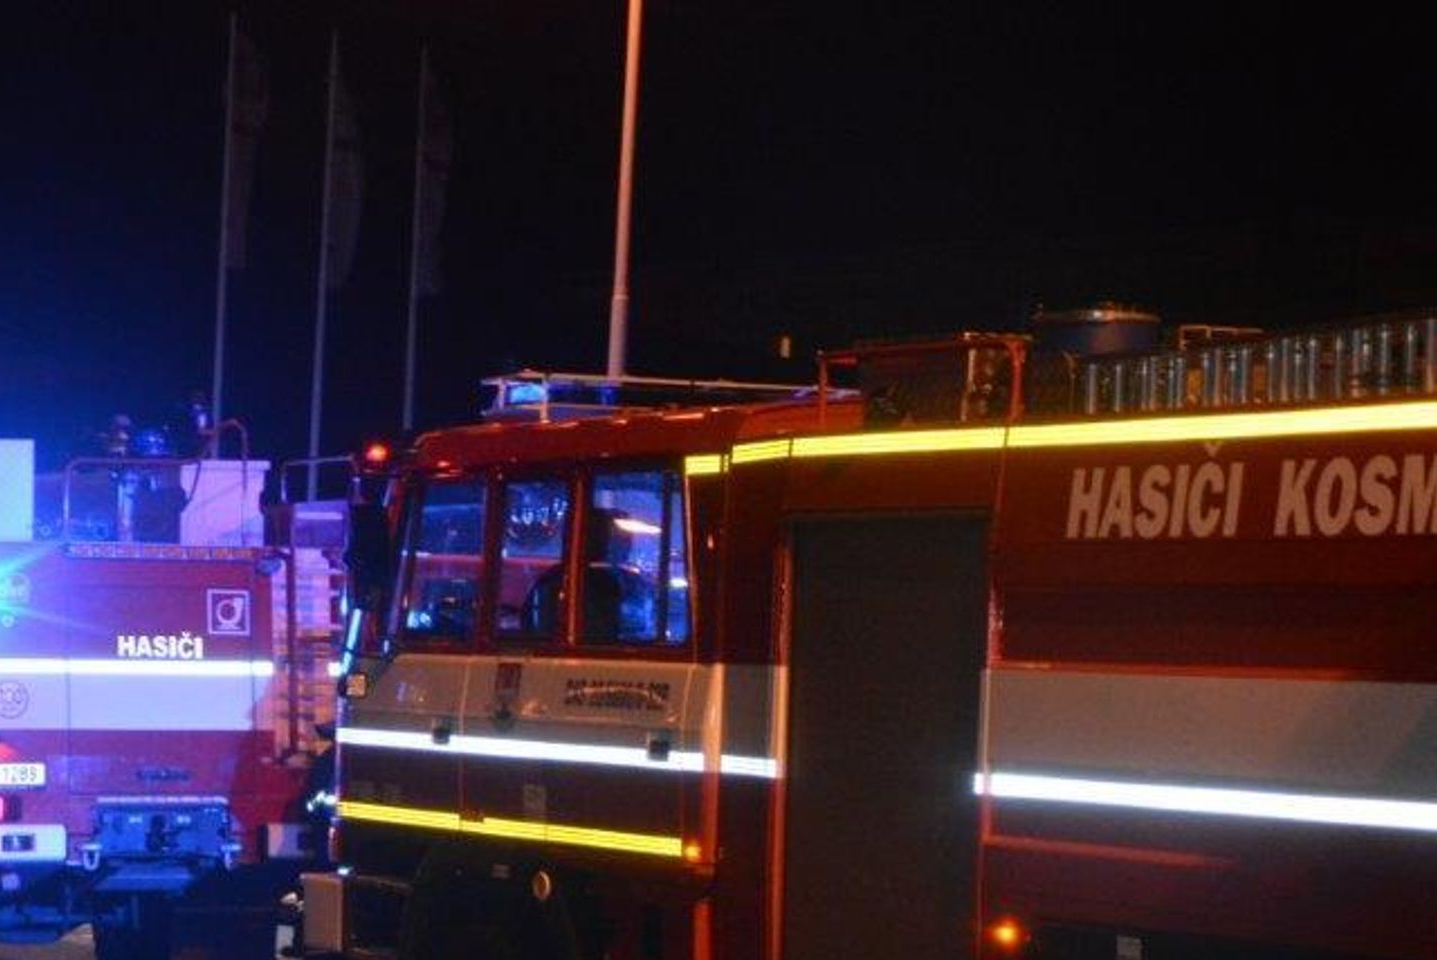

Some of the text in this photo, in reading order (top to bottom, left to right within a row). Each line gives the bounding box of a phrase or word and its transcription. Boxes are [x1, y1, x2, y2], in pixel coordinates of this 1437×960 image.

[1066, 440, 1437, 540] HASIČI KOSM
[116, 631, 204, 659] HASIČI
